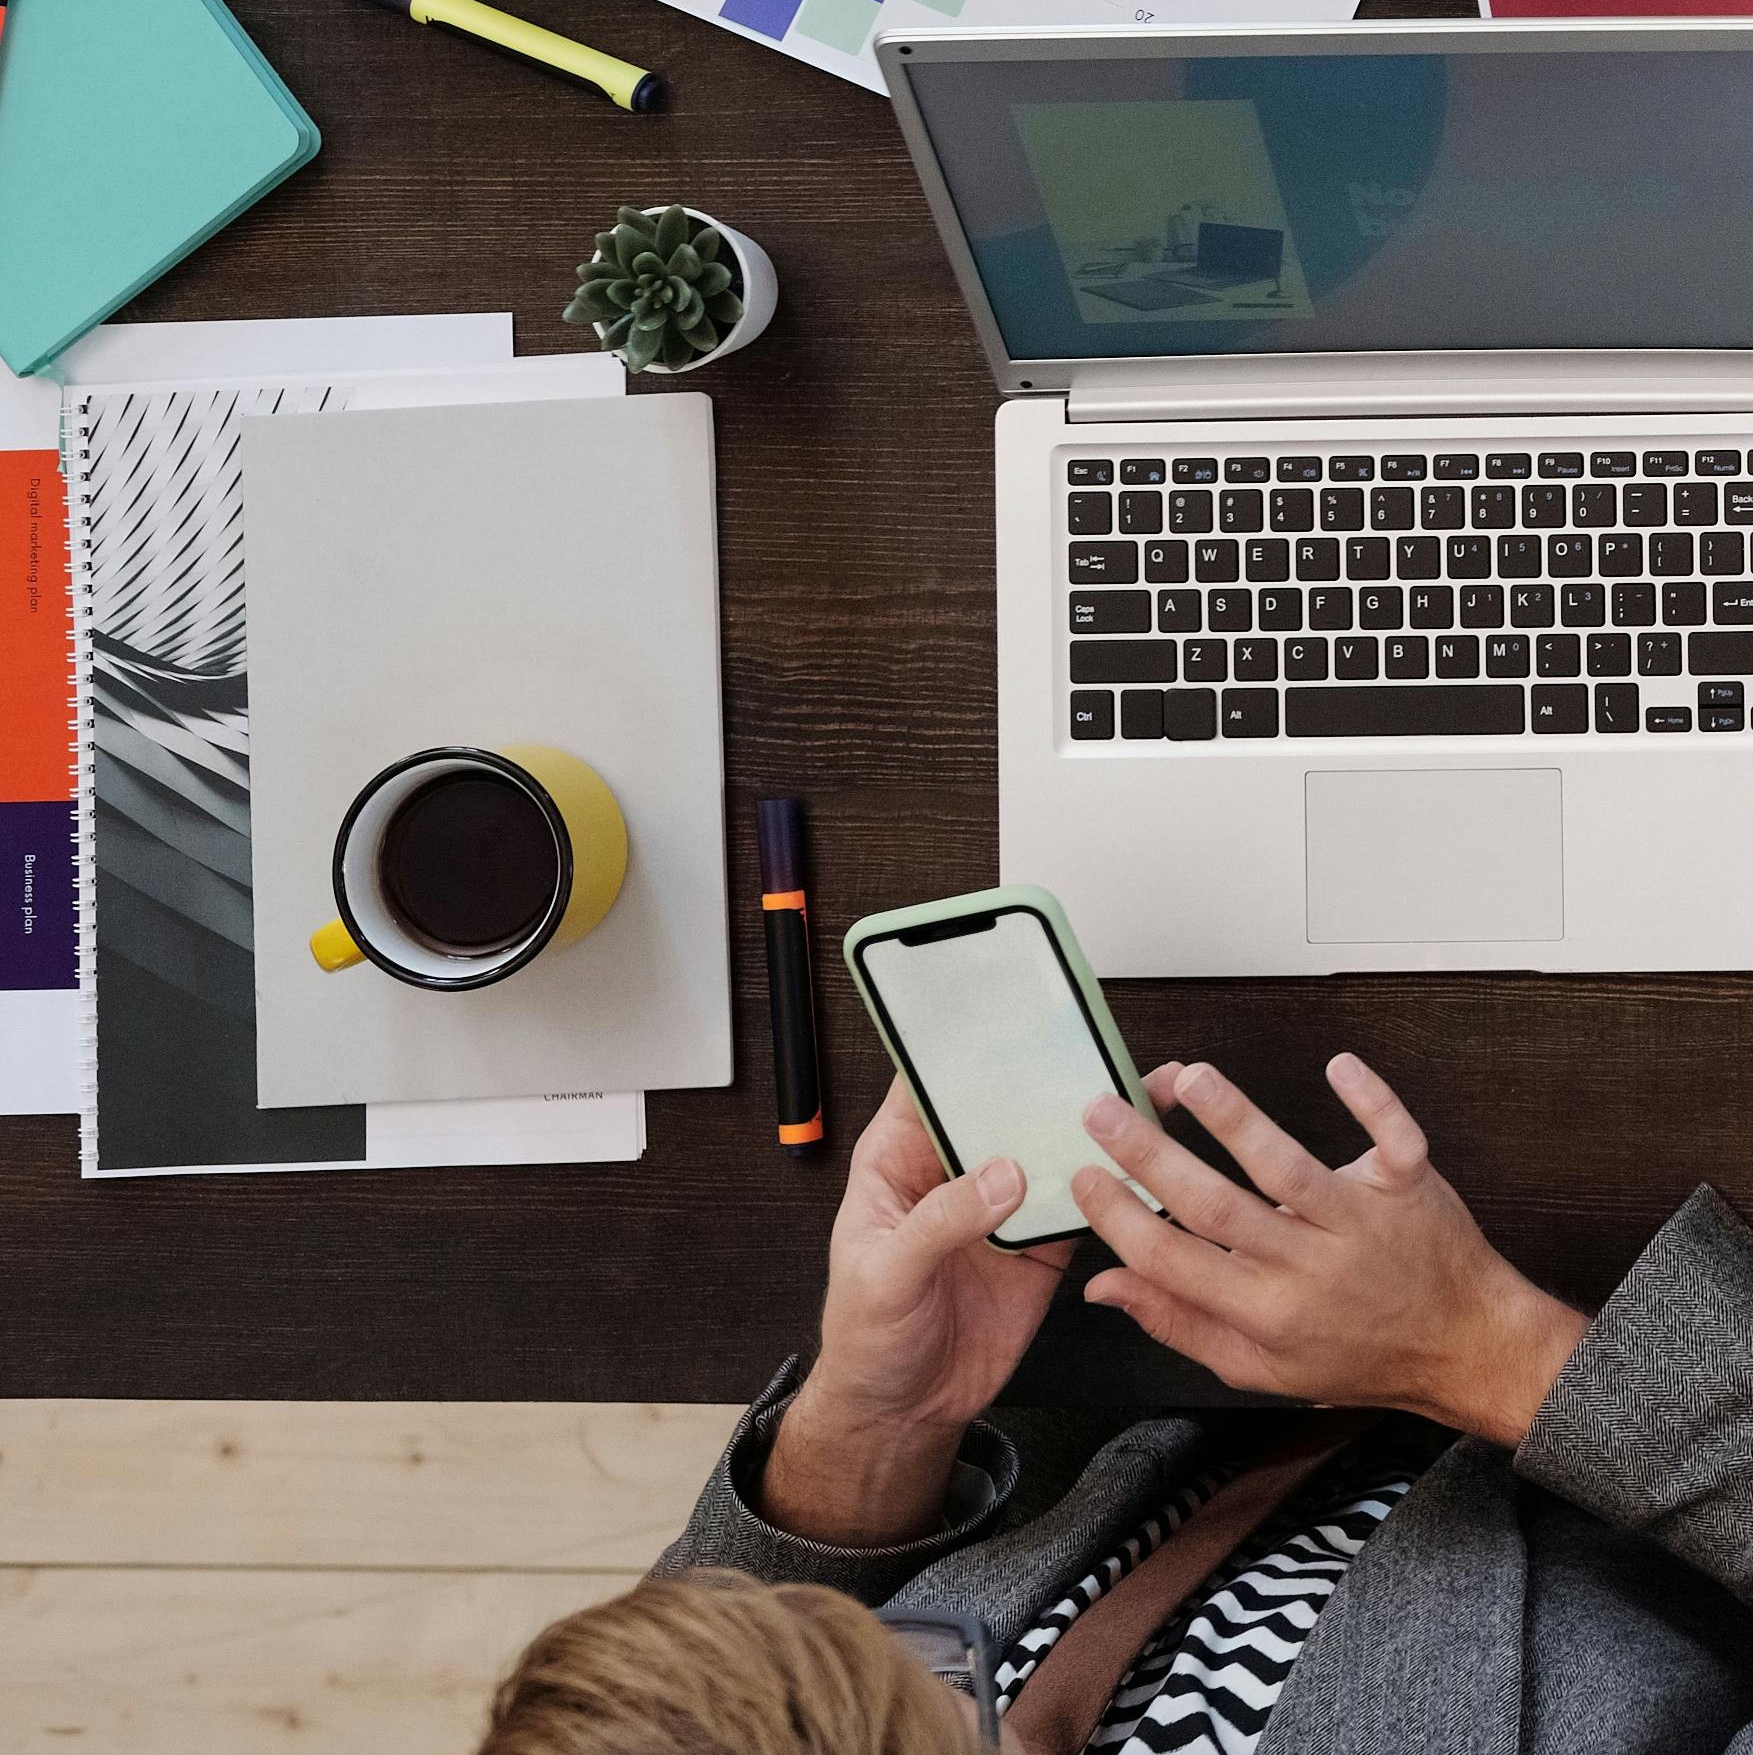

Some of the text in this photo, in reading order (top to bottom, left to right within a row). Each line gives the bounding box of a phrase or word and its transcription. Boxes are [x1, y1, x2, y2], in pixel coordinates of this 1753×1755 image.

[1135, 10, 1154, 23] 20
[27, 479, 42, 613] Digital marketing plan
[1151, 549, 1163, 562] Q
[1203, 549, 1217, 561] W
[1253, 548, 1262, 560] E
[1303, 547, 1313, 559] R
[1353, 546, 1363, 559] T
[1404, 546, 1414, 557] Y
[1454, 545, 1464, 557] U
[1556, 543, 1567, 555] O
[1606, 543, 1615, 555] P
[1076, 605, 1094, 614] Caps
[1165, 599, 1175, 611] A
[1216, 598, 1226, 611] S
[1266, 598, 1276, 610] D
[1317, 597, 1325, 609] F
[1367, 596, 1378, 609] G
[1418, 596, 1427, 607] H
[1468, 594, 1475, 606] J
[1518, 593, 1528, 606] K
[1569, 593, 1578, 605] L
[1191, 644, 1505, 661] Z X C V B N M
[1077, 706, 1552, 721] Ctrl Alt Alt
[21, 855, 37, 934] Business plan
